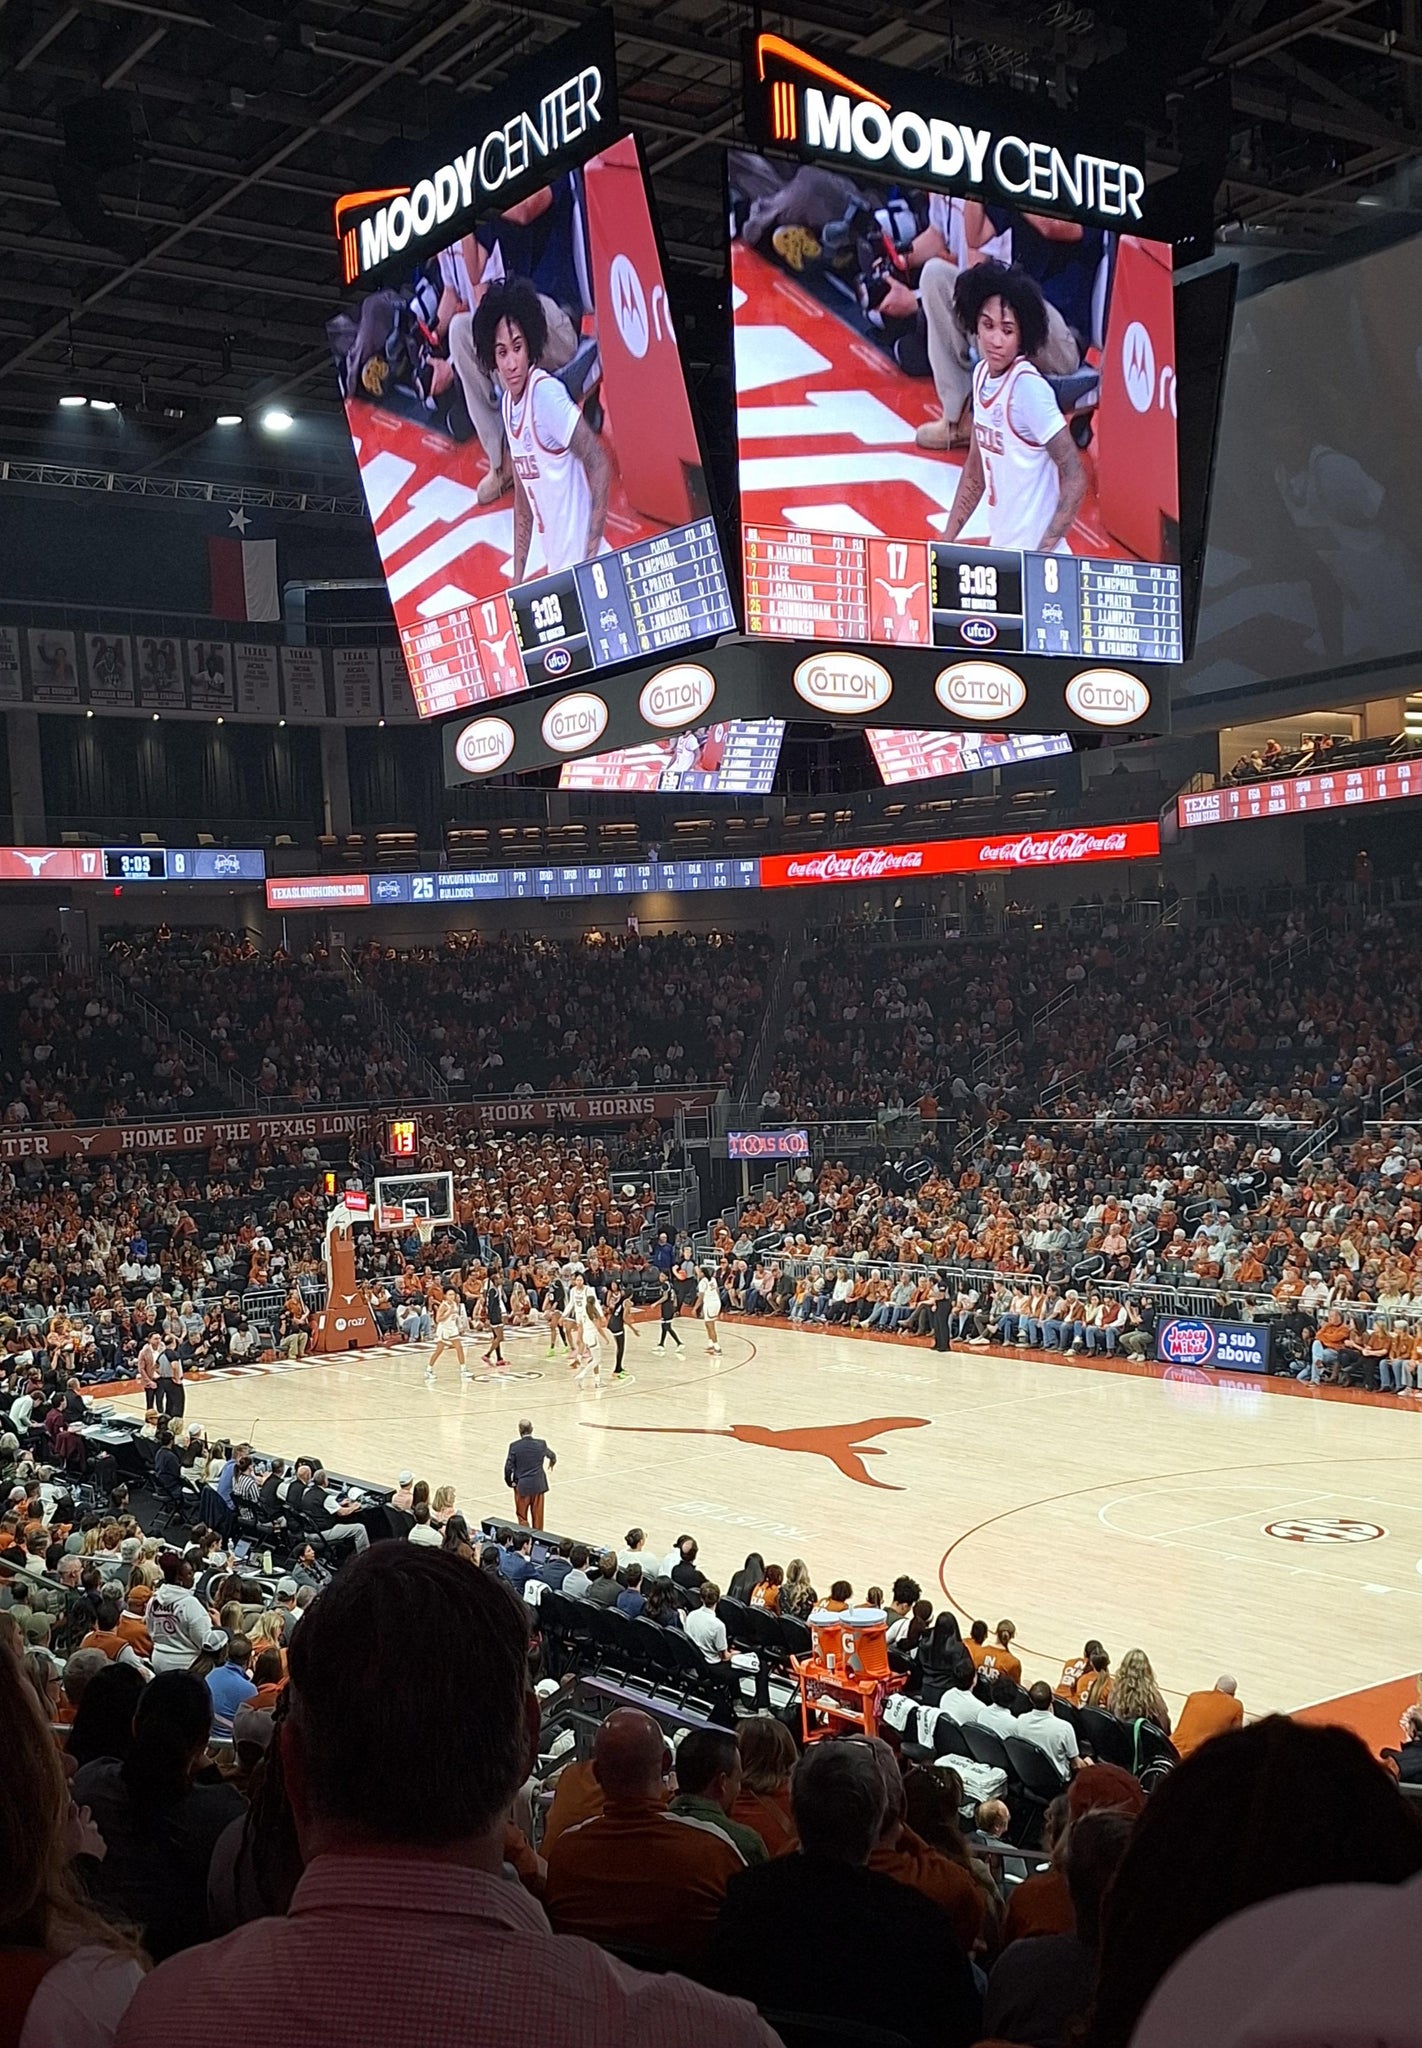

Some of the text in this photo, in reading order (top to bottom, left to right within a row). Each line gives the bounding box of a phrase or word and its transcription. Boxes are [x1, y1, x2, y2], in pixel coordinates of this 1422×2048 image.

[804, 87, 1144, 220] MOODY CENTER
[359, 65, 601, 272] MOODY CENTER
[835, 552, 842, 567] 2
[856, 553, 863, 569] 0
[886, 543, 908, 580] 17
[592, 563, 608, 600] 8
[751, 562, 758, 577] 7
[857, 571, 863, 587] 0
[958, 564, 997, 596] 3:03
[1044, 558, 1059, 593] 8
[752, 580, 759, 596] 11
[837, 588, 843, 603] 2
[857, 589, 864, 605] 0
[1083, 575, 1089, 588] 2
[1152, 580, 1158, 594] 0
[1169, 582, 1175, 596] 0
[531, 594, 562, 629] 3:03
[750, 599, 760, 614] 25
[838, 606, 844, 621] 0
[858, 607, 864, 622] 0
[1083, 592, 1089, 605] 5
[1152, 597, 1159, 610] 2
[1170, 599, 1175, 612] 0
[481, 600, 498, 637] 17
[1153, 613, 1159, 627] 0
[1170, 615, 1176, 628] 0
[838, 624, 844, 639] 5
[858, 625, 865, 640] 0
[966, 623, 992, 638] ufcu
[1153, 629, 1159, 643] 0
[1171, 631, 1176, 643] 0
[243, 646, 267, 657] TEXAS
[289, 649, 313, 660] TEXAS
[343, 651, 369, 660] TEXAS
[548, 654, 567, 669] ufcu
[1171, 646, 1177, 659] 0
[808, 667, 877, 700] COTTON
[948, 675, 1012, 707] COTTON
[650, 680, 702, 715] COTTON
[1078, 682, 1136, 712] COTTON
[551, 709, 596, 741] COTTON
[463, 732, 505, 761] COTTON
[1184, 795, 1220, 812] TEXAS
[1233, 806, 1239, 818] 7
[1251, 802, 1260, 815] 12
[1324, 792, 1331, 805] 5
[81, 853, 96, 873] 17
[121, 855, 151, 872] 3:03
[175, 853, 185, 873] 8
[513, 871, 527, 882] PTS
[613, 867, 626, 878] AST
[663, 864, 675, 875] STL
[715, 862, 724, 873] FT
[271, 884, 365, 900] TEXASLONGHORNS.COM
[412, 877, 433, 899] 25
[439, 887, 474, 899] BULLDOGS
[518, 875, 750, 895] 0 0 1 1 0 0 0 0 0-0 5
[480, 1104, 535, 1122] HOOK
[588, 1098, 655, 1117] HORNS
[121, 1118, 316, 1149] HOME OF THE TEXAS
[397, 1133, 413, 1152] 13
[0, 1137, 49, 1157] TER
[348, 1317, 367, 1328] razr
[1168, 1326, 1207, 1343] Jersey
[1218, 1332, 1256, 1348] a sub
[1217, 1346, 1263, 1363] above
[842, 1633, 854, 1653] G
[984, 1655, 996, 1667] IN
[978, 1666, 1000, 1680] OUR
